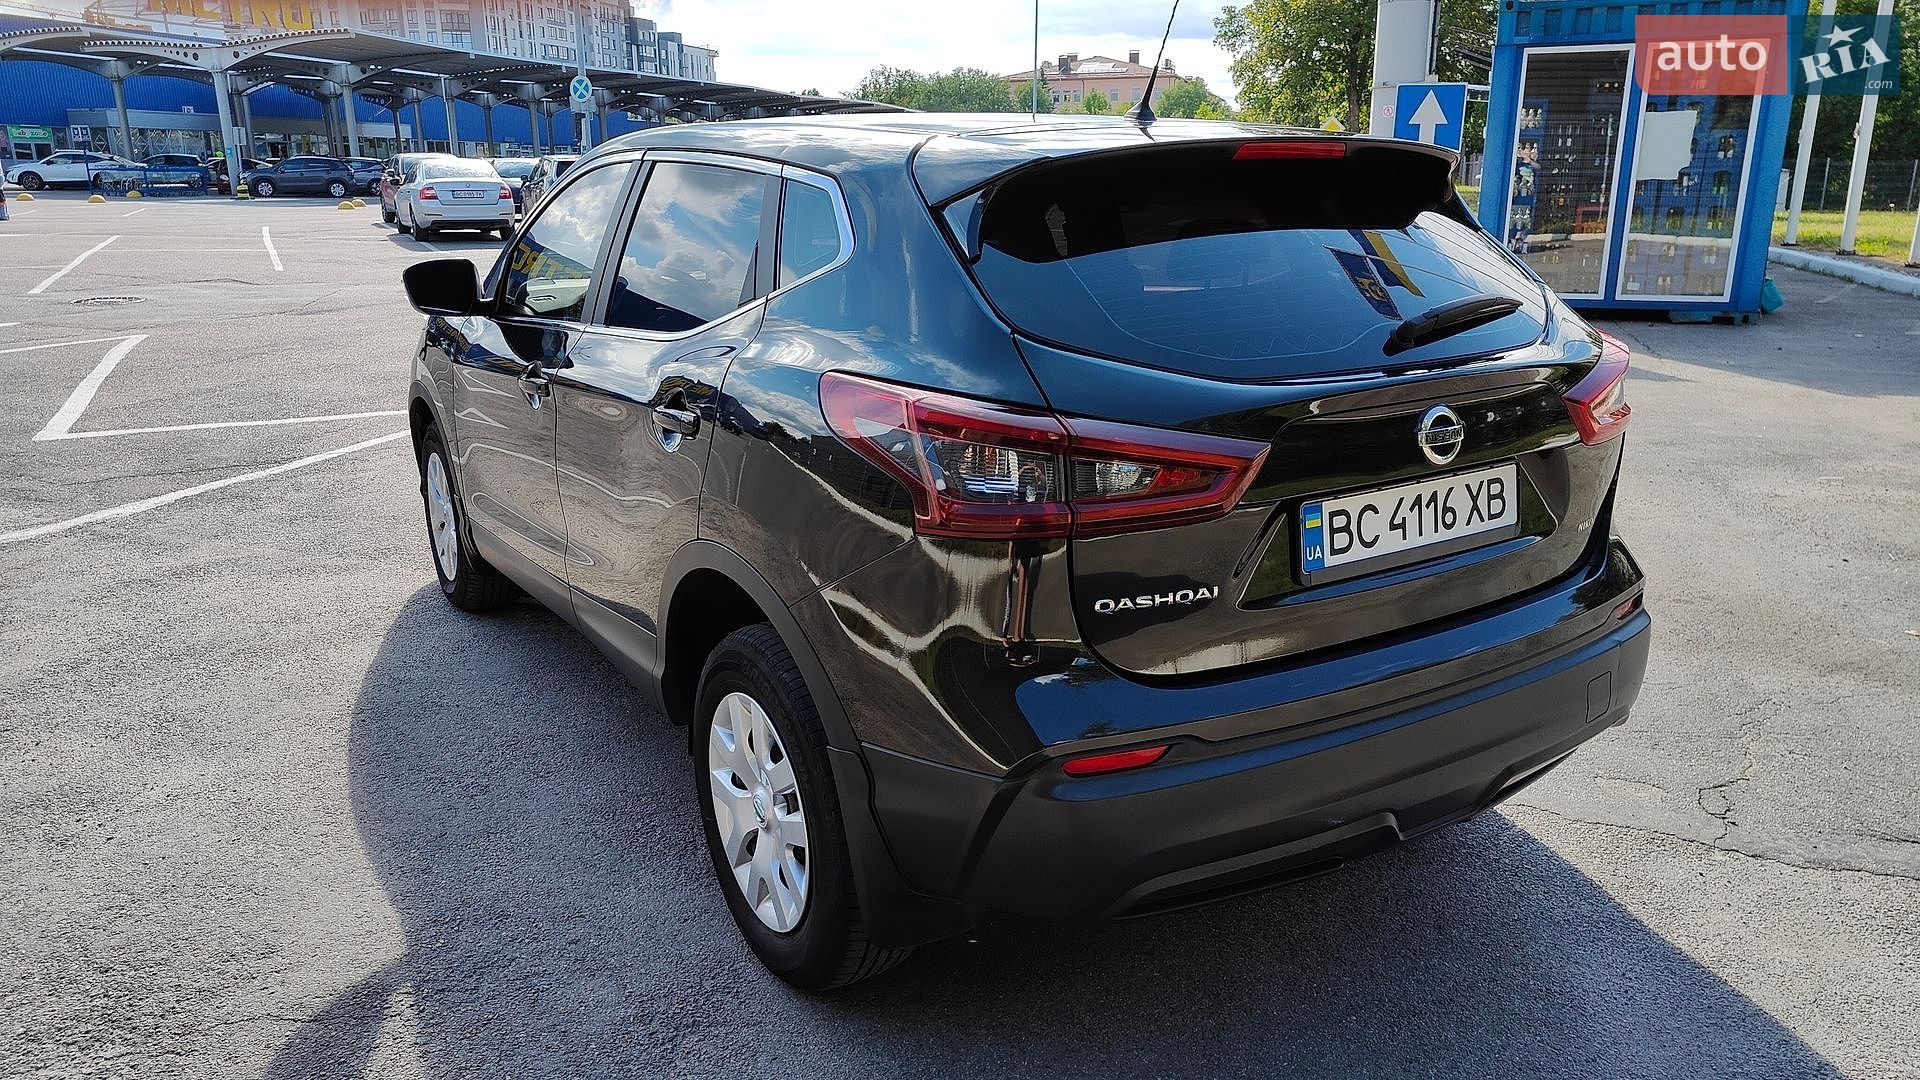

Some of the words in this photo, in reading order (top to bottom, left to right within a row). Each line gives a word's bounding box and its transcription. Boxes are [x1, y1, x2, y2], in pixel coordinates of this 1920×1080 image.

[1424, 428, 1461, 443] NISSAN
[1328, 503, 1380, 556] BC
[1388, 486, 1457, 541] 4116
[1464, 476, 1507, 526] XB
[1306, 547, 1323, 561] UA
[1094, 585, 1219, 615] QASHQAI
